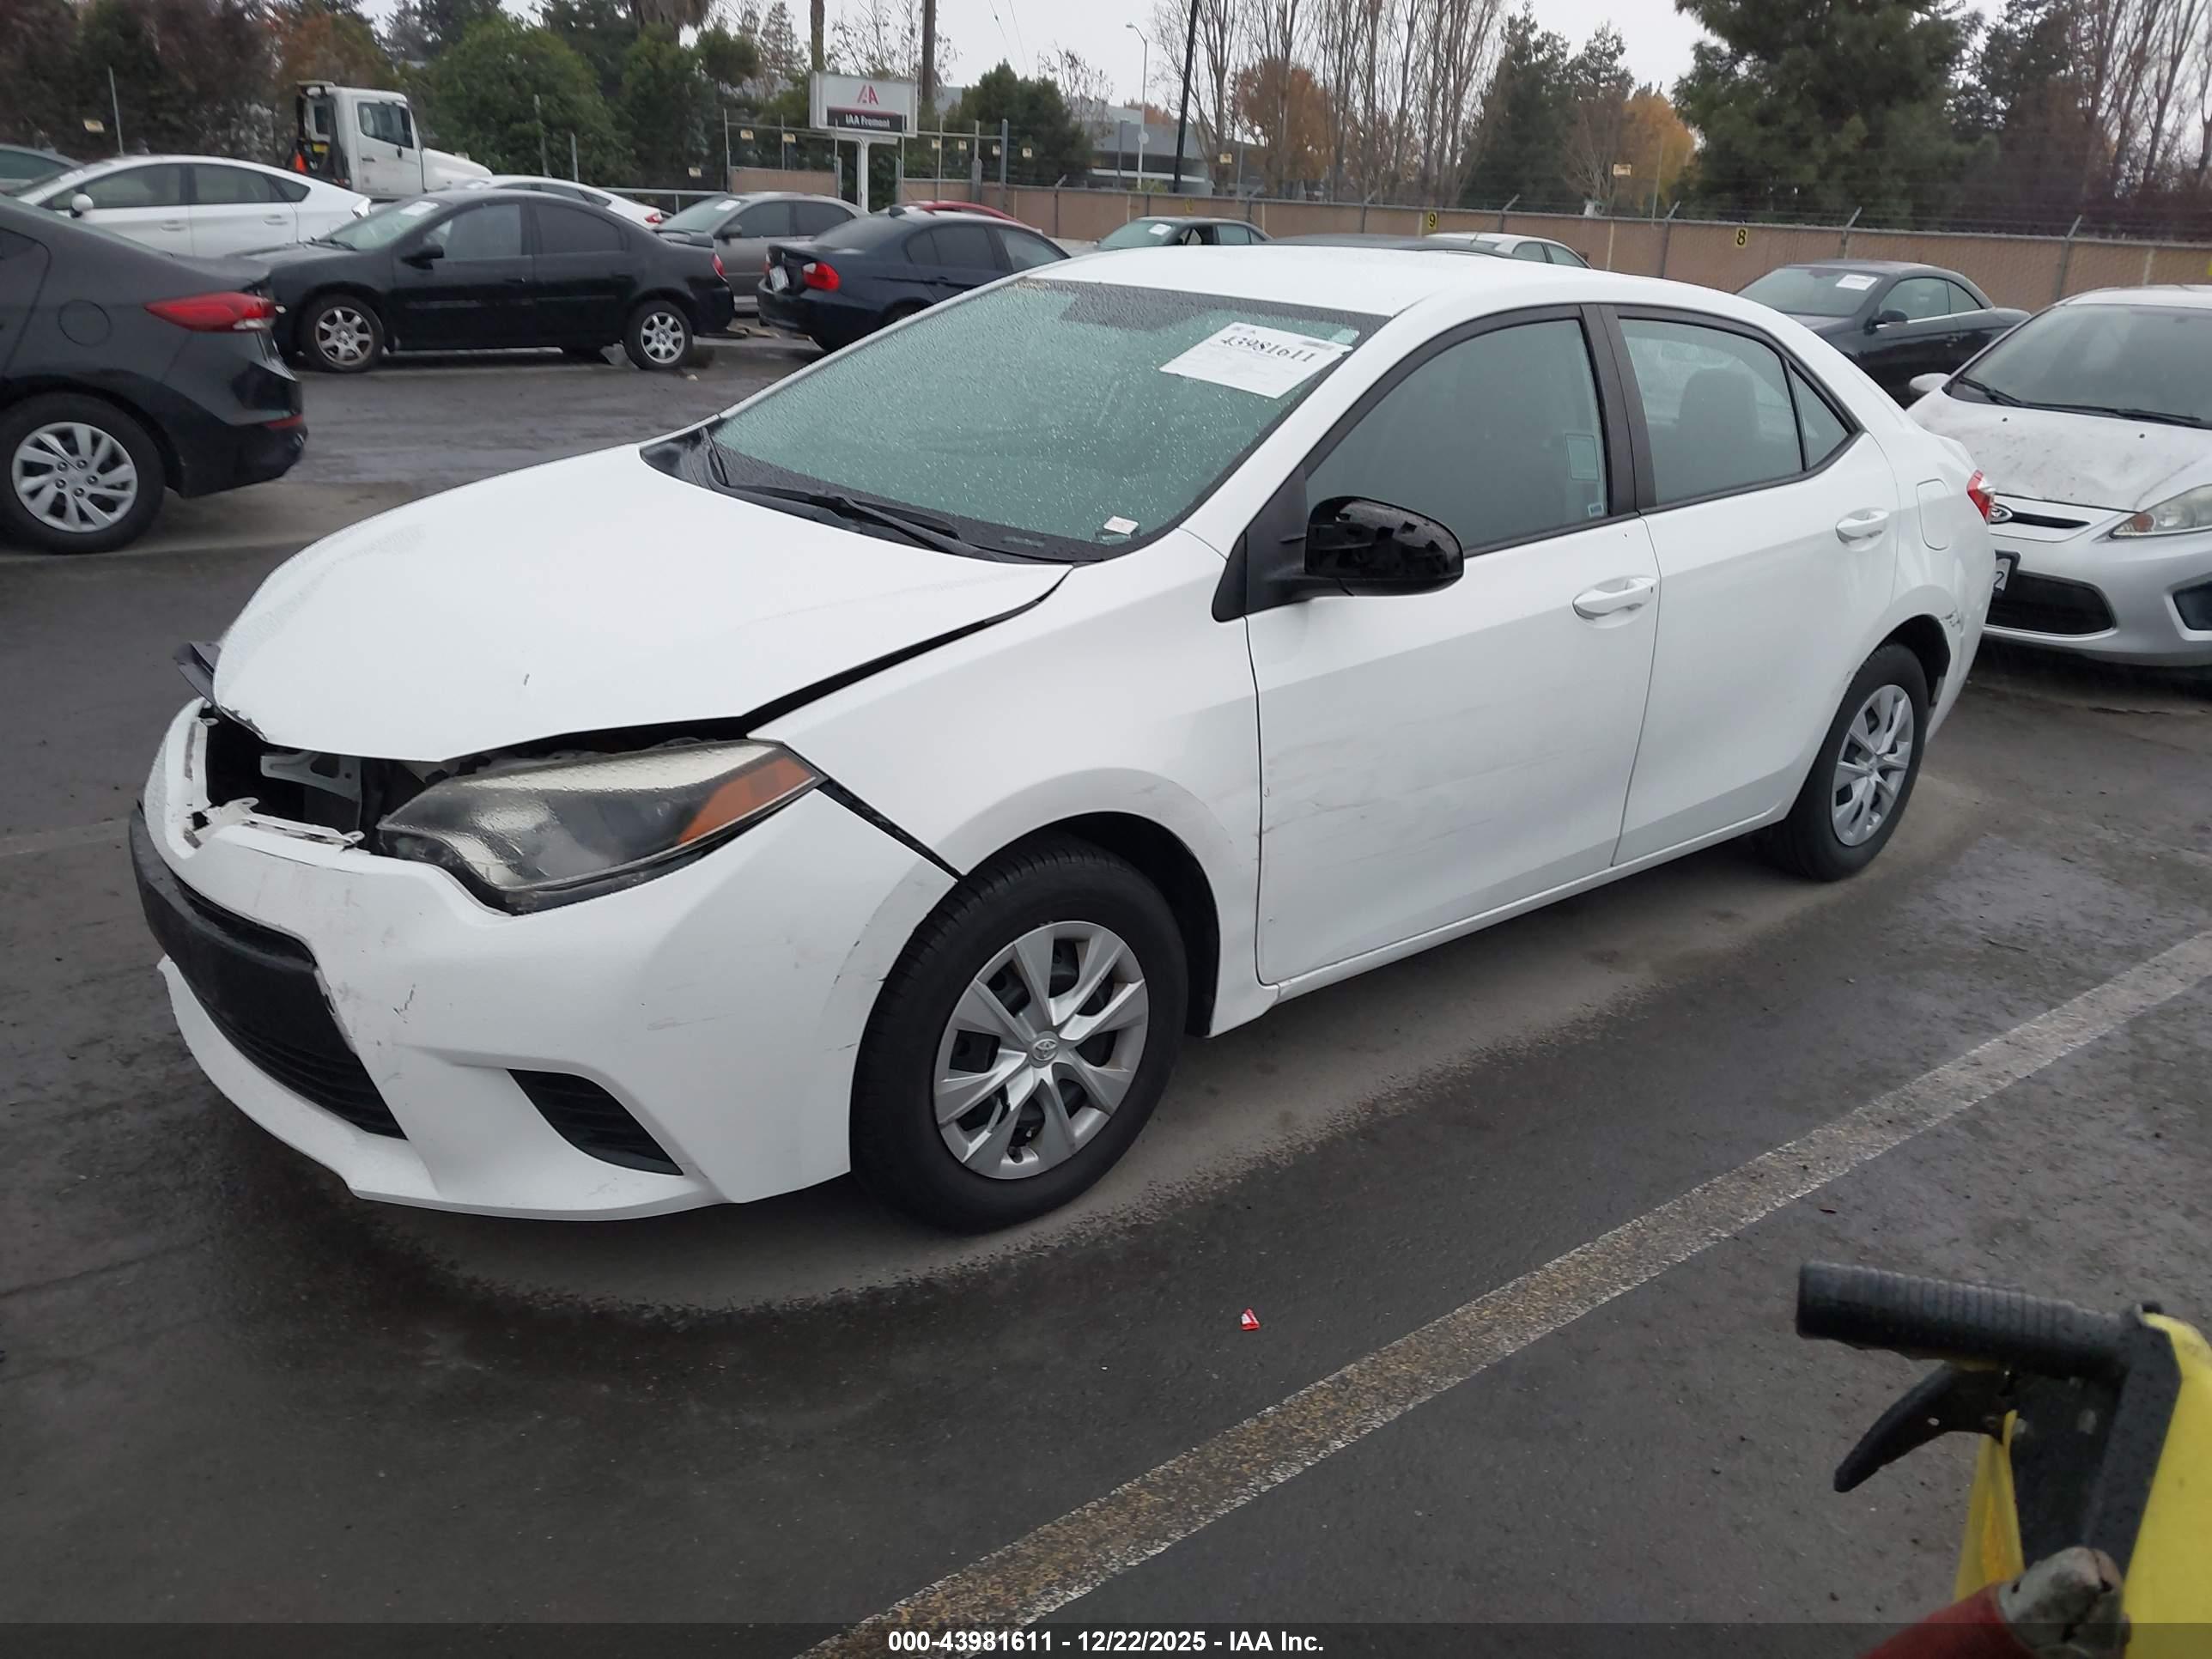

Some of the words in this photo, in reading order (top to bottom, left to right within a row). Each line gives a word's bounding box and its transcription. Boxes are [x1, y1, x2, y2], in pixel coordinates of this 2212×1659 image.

[845, 113, 860, 125] IAA
[1429, 213, 1436, 228] 9
[1737, 228, 1746, 246] 8
[1221, 336, 1317, 362] 43981611
